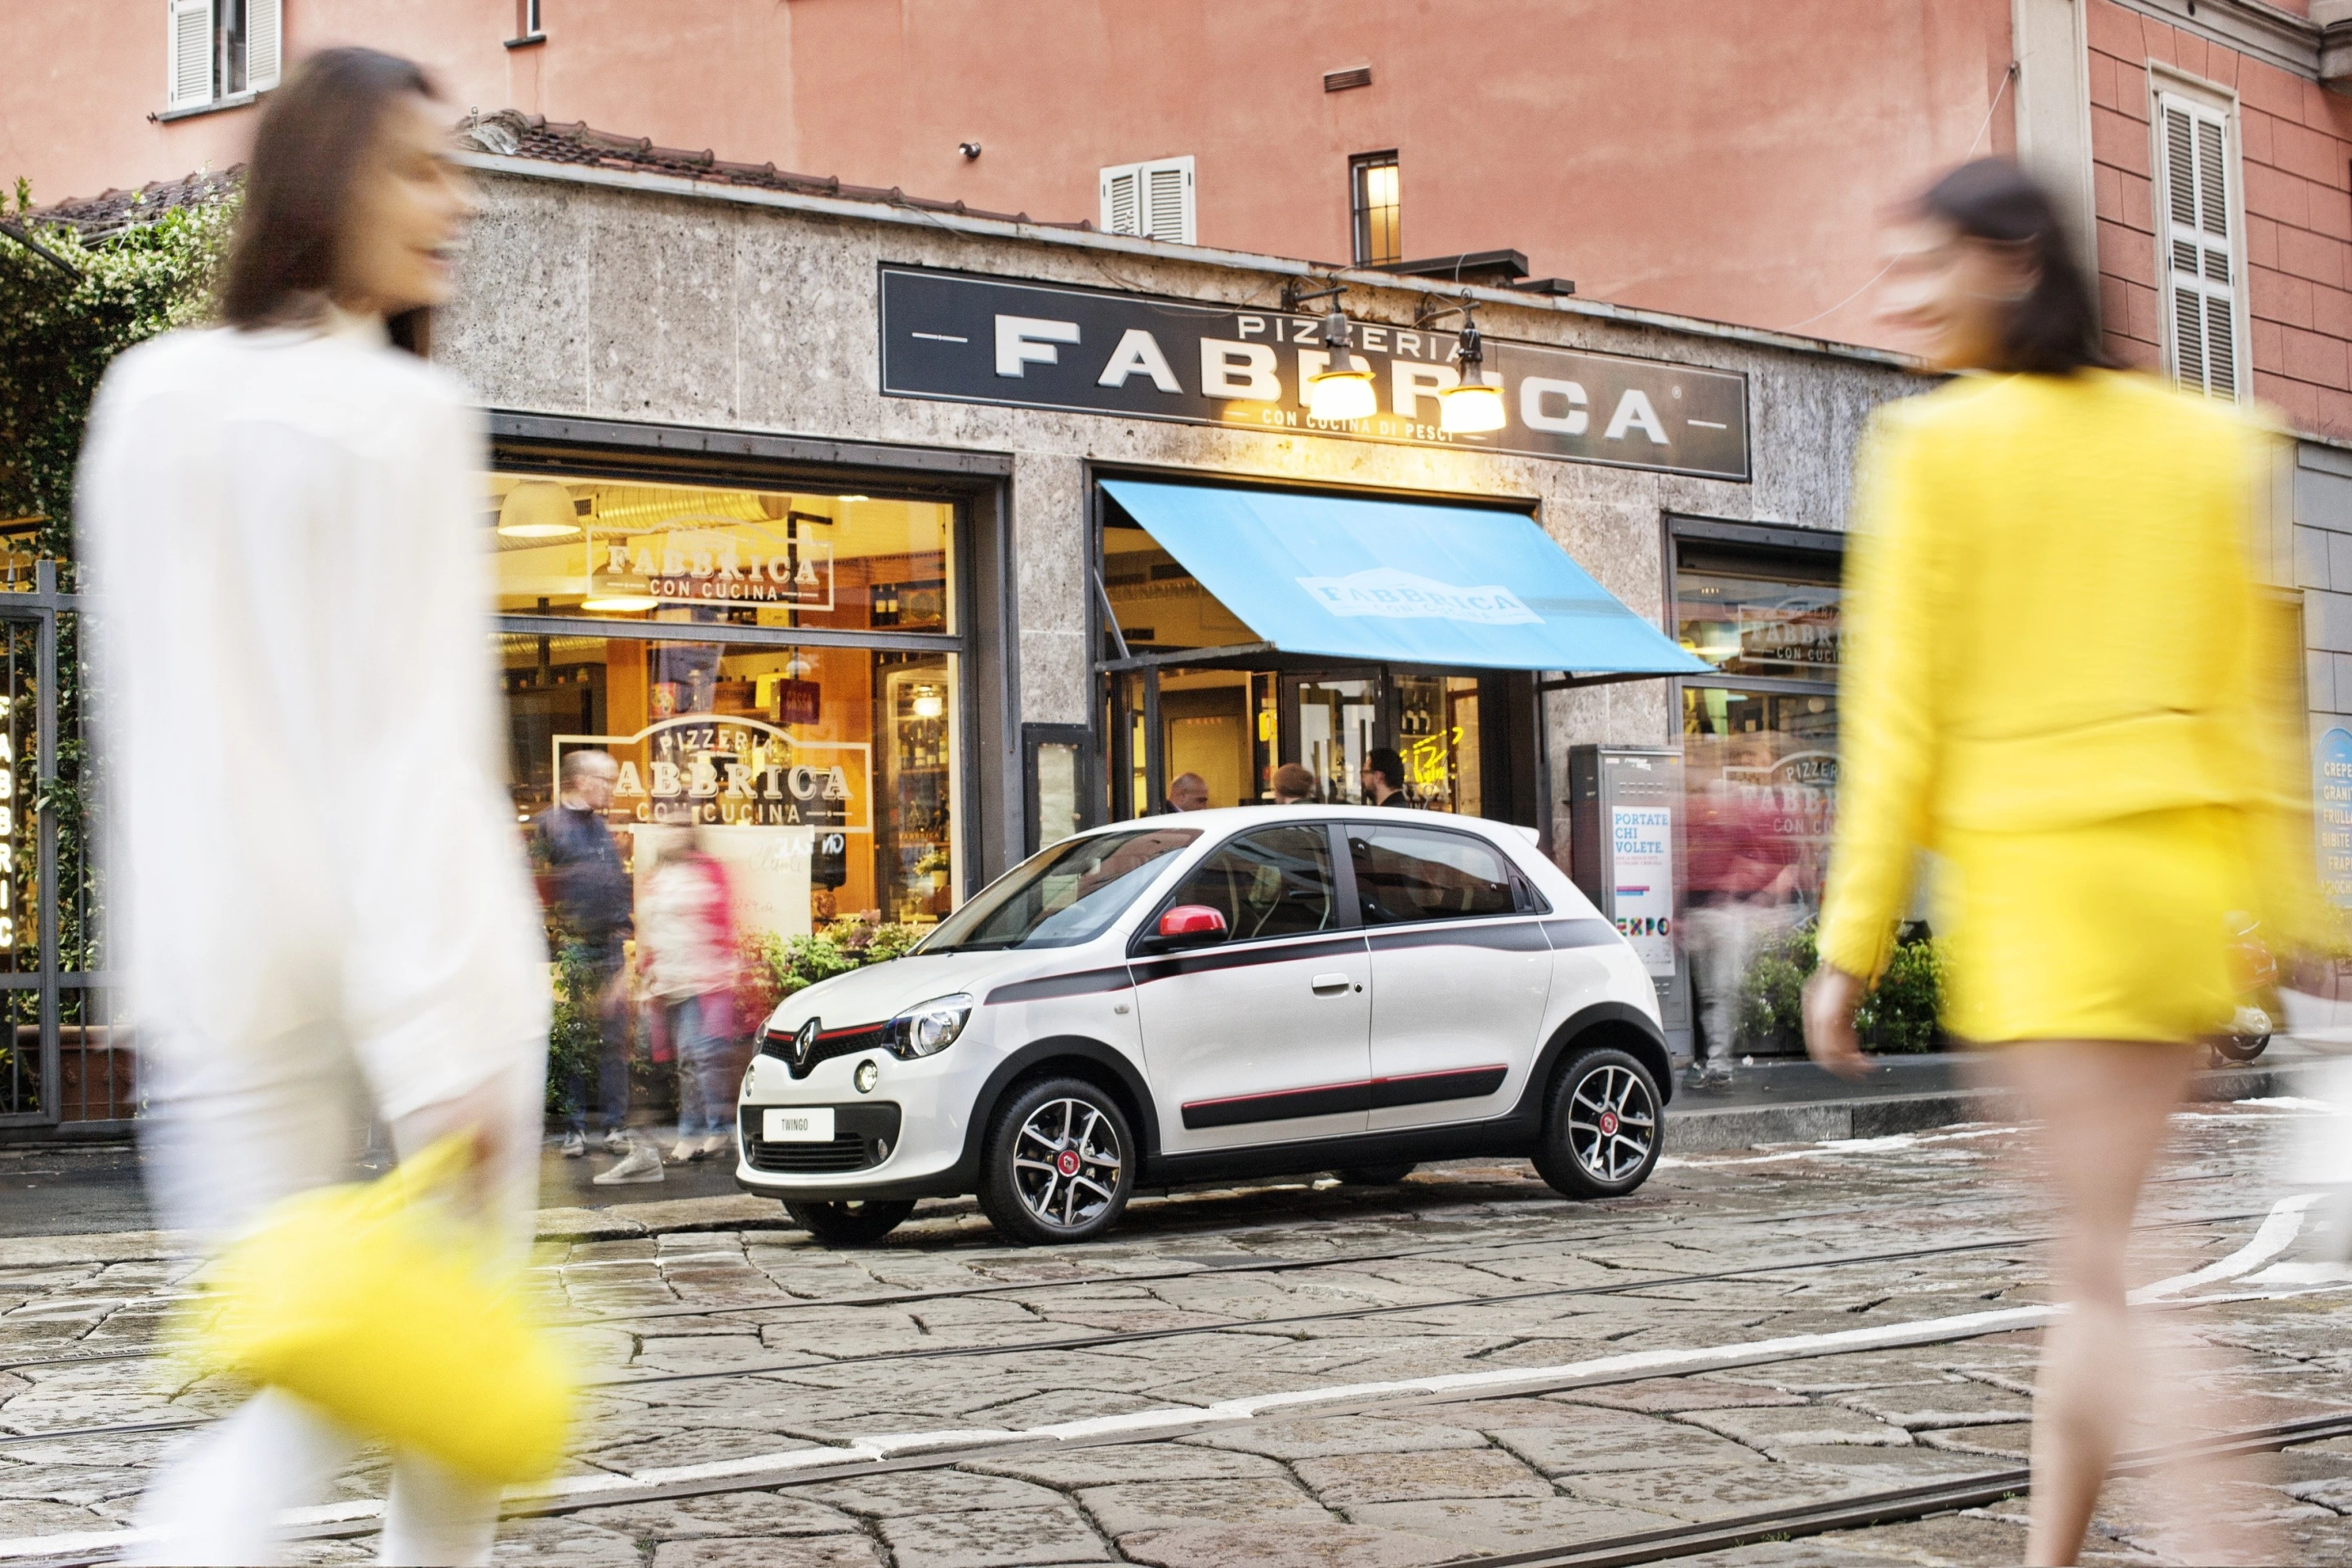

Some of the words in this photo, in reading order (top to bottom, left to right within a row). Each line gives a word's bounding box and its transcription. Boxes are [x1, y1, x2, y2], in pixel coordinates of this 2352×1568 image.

[1262, 409, 1297, 427] CON
[1379, 421, 1396, 436] DI
[606, 544, 820, 585] FABBRICA
[650, 579, 690, 597] CON
[702, 582, 777, 601] CUCINA
[1318, 586, 1521, 611] FABBRICA
[1776, 647, 1801, 659] CON
[659, 729, 774, 756] PIZZERIA
[612, 760, 853, 800] ABBRICA
[703, 803, 800, 823] CUCINA
[1615, 813, 1668, 825] PORTATE
[1615, 827, 1638, 839] CHI
[1774, 818, 1804, 833] CON
[1615, 841, 1664, 853] VOLETE.
[2322, 833, 2350, 847] BIBITE
[1616, 916, 1670, 937] EXPO
[782, 1118, 808, 1131] TWINGO
